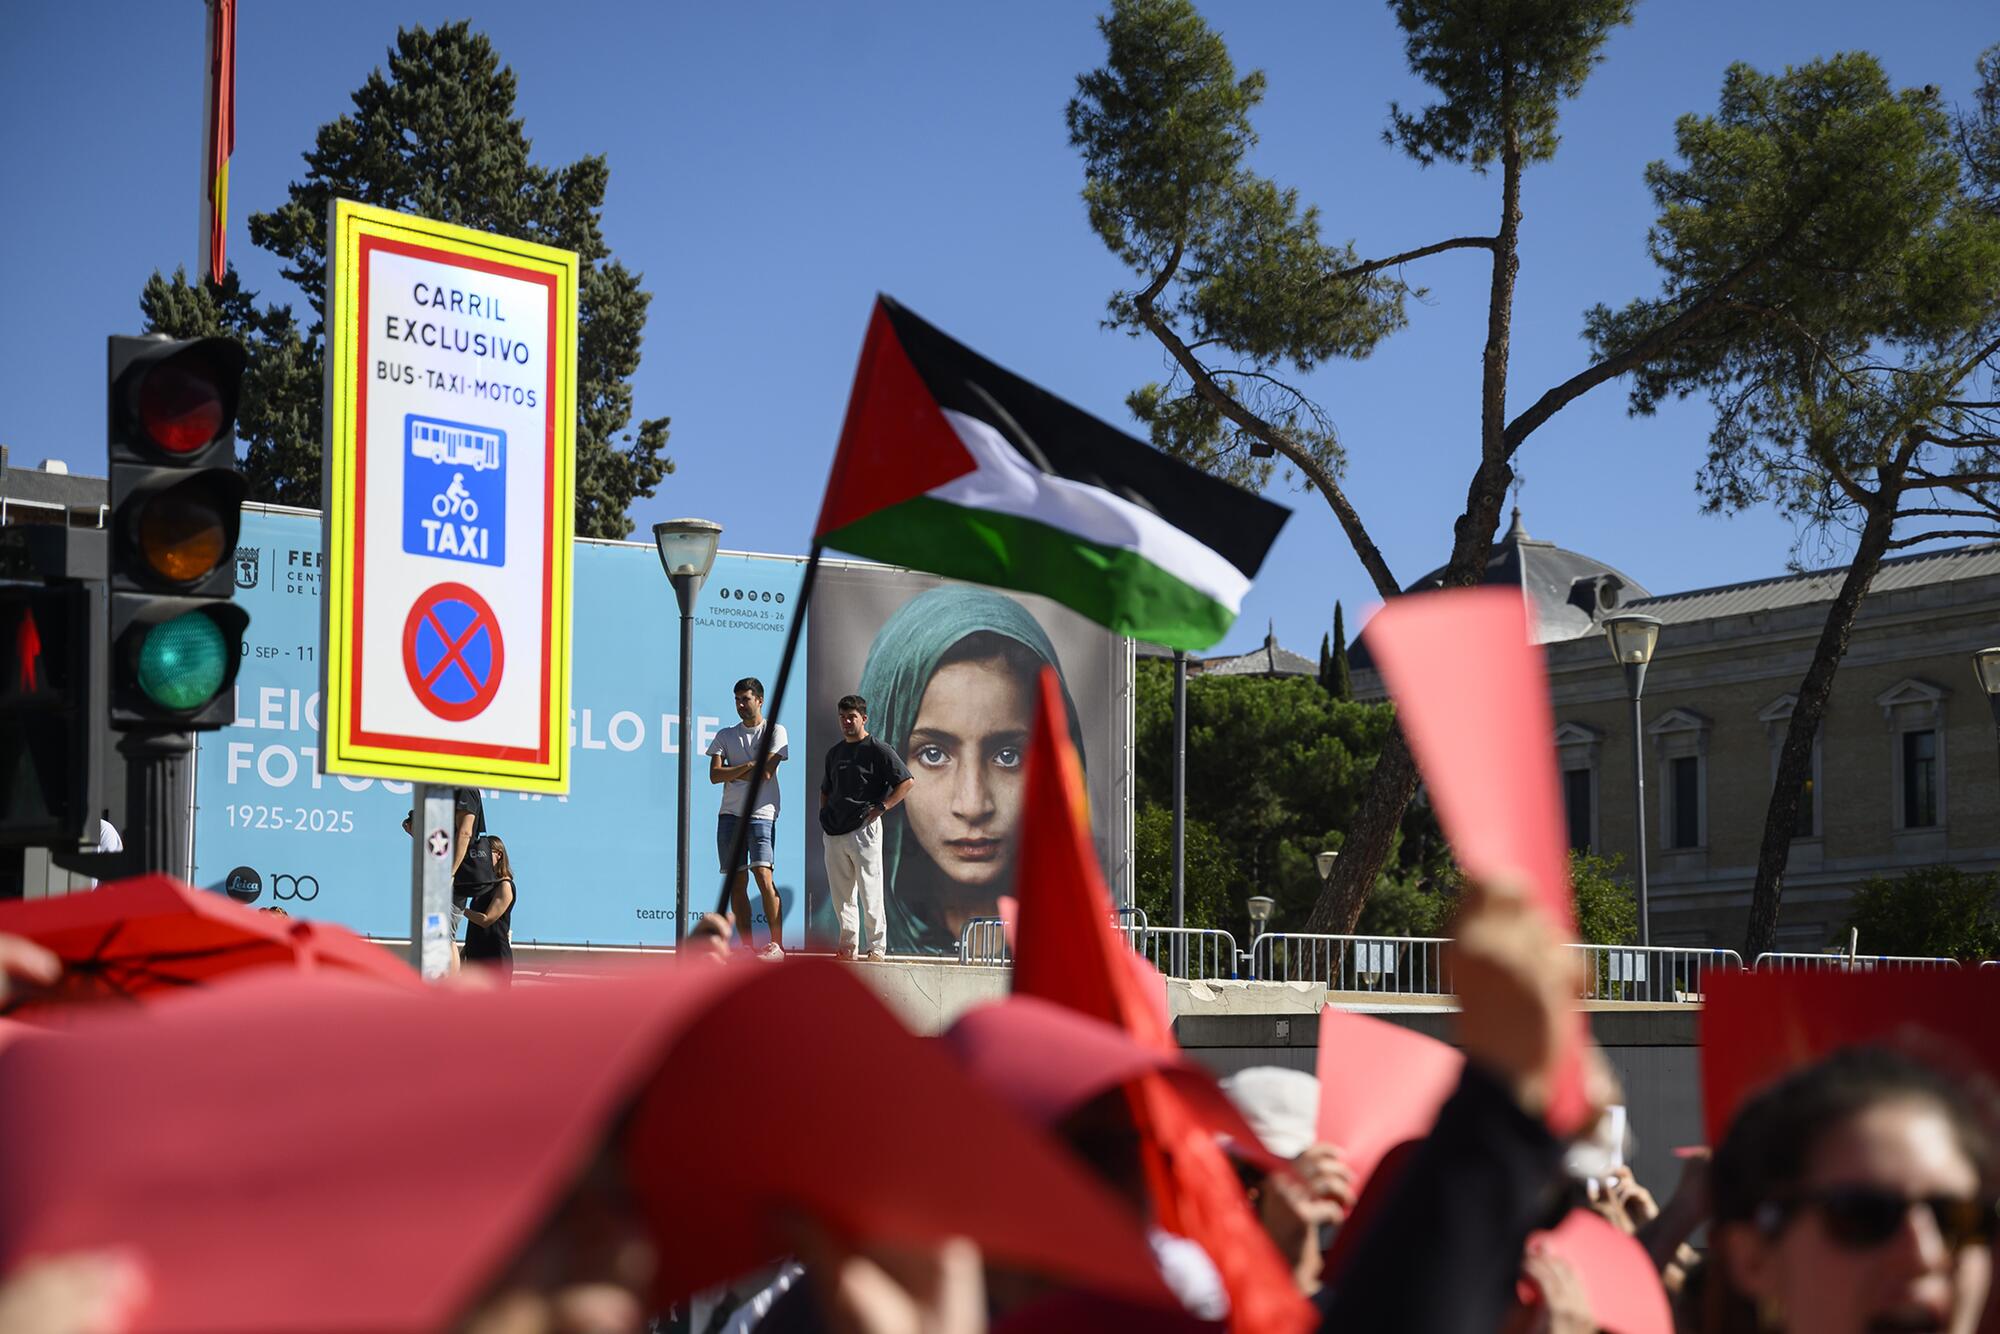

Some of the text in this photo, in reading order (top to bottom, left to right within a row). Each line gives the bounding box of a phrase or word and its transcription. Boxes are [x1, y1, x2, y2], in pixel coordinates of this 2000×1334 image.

[413, 282, 506, 322] CARRIL
[386, 315, 529, 366] EXCLUSIVO
[421, 519, 488, 560] TAXI
[288, 585, 303, 595] DE
[695, 617, 784, 632] SALA DE EXPOSICIONES
[709, 606, 758, 618] TEMPORADA
[760, 610, 768, 619] 25
[775, 611, 784, 620] 26
[241, 641, 250, 657] 0
[256, 646, 279, 659] SEP
[297, 646, 313, 661] 11
[661, 714, 719, 756] DE
[226, 804, 354, 833] 1925-2025
[229, 873, 319, 901] Leica 100
